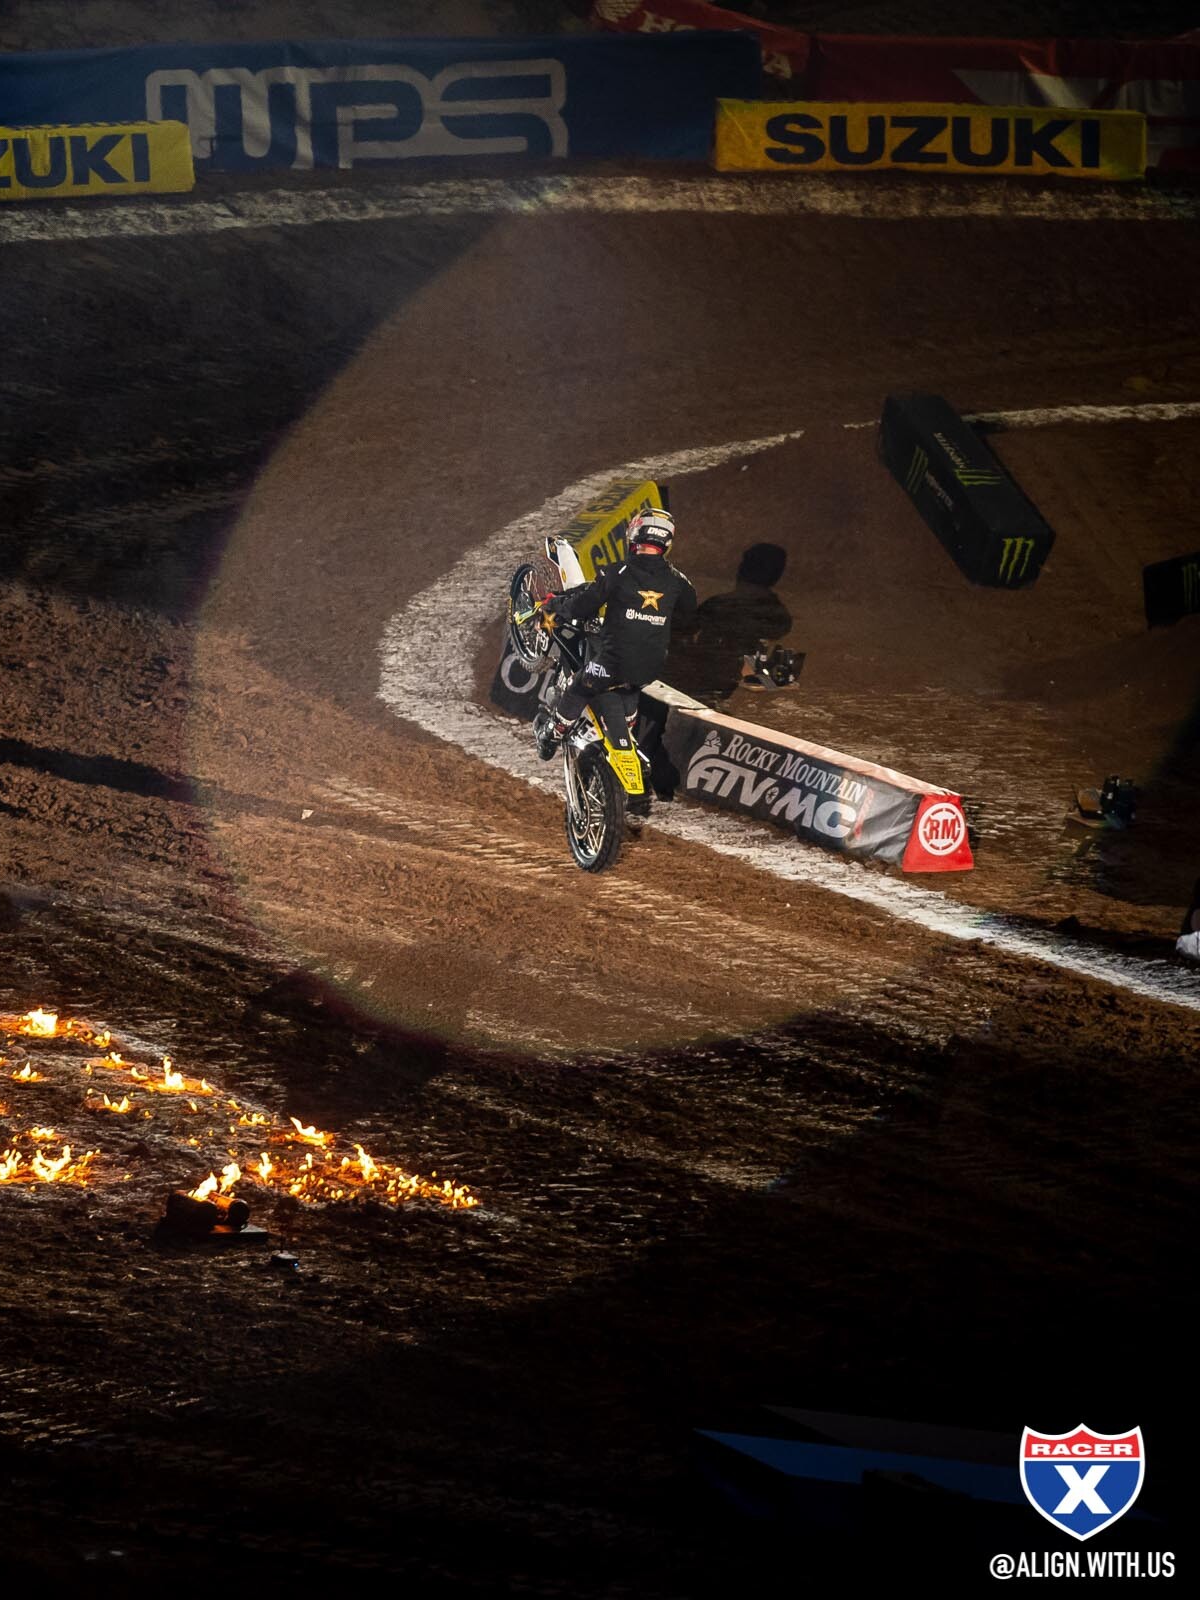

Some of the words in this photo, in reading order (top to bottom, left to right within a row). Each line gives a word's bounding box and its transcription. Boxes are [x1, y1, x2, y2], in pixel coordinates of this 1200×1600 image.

[765, 114, 1100, 168] SUZUKI
[722, 734, 781, 772] ROCKY
[777, 753, 868, 803] MOUNTAIN
[928, 818, 957, 840] RM
